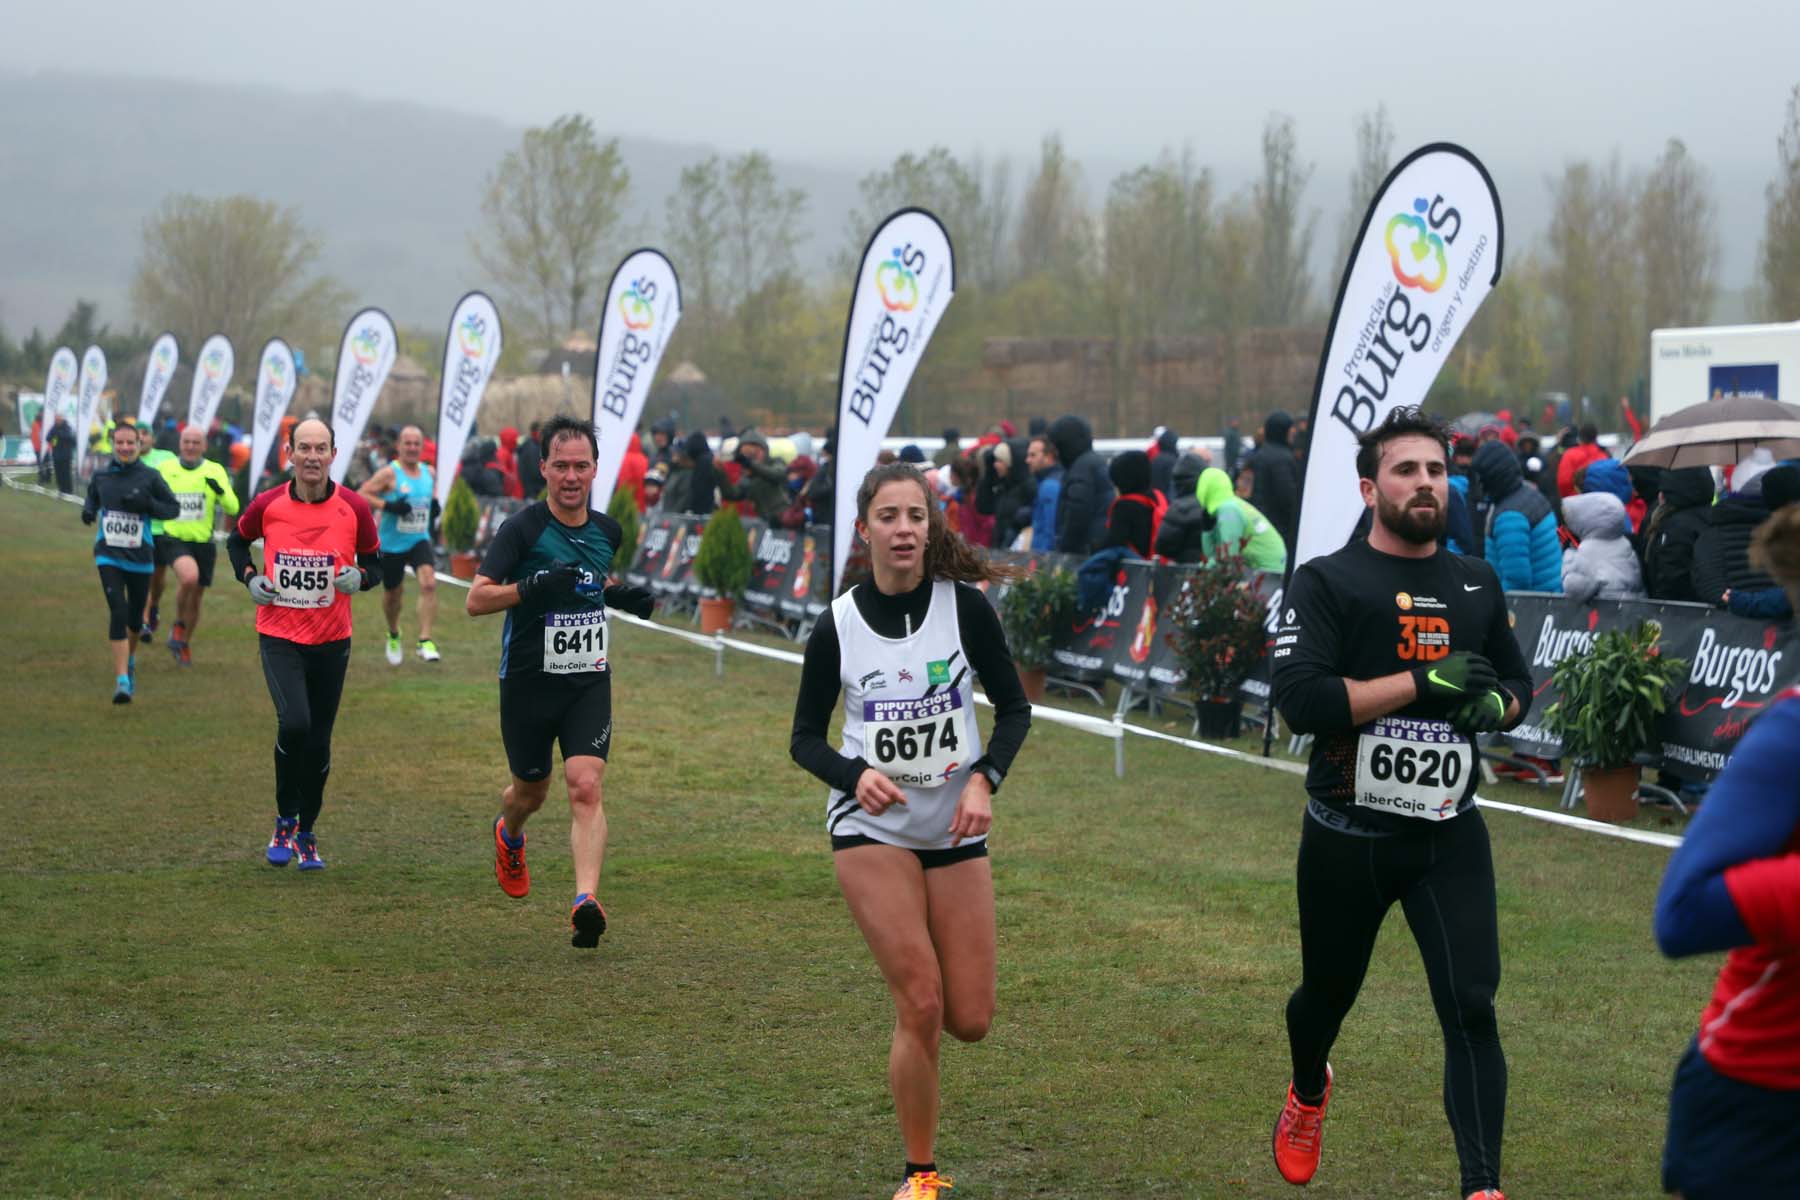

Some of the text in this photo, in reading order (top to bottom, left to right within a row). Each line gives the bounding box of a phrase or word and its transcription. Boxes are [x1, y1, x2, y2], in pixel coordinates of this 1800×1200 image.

[1431, 232, 1489, 354] origen y destino
[1343, 295, 1387, 380] Provincia
[105, 521, 139, 537] 6049
[278, 553, 328, 564] DIPUTACIÓN
[279, 568, 329, 591] 6455
[553, 608, 604, 621] DIPUTACIÓN
[553, 626, 604, 655] 6411
[549, 661, 588, 671] iberCaja
[874, 691, 951, 713] DIPUTACIÓN
[874, 701, 953, 721] BURGOS
[1374, 725, 1461, 744] BURGOS
[1375, 716, 1453, 733] DIPUTACIÓ
[875, 716, 959, 764] 6674
[1370, 743, 1462, 789] 6620
[1363, 792, 1427, 812] iberCaja
